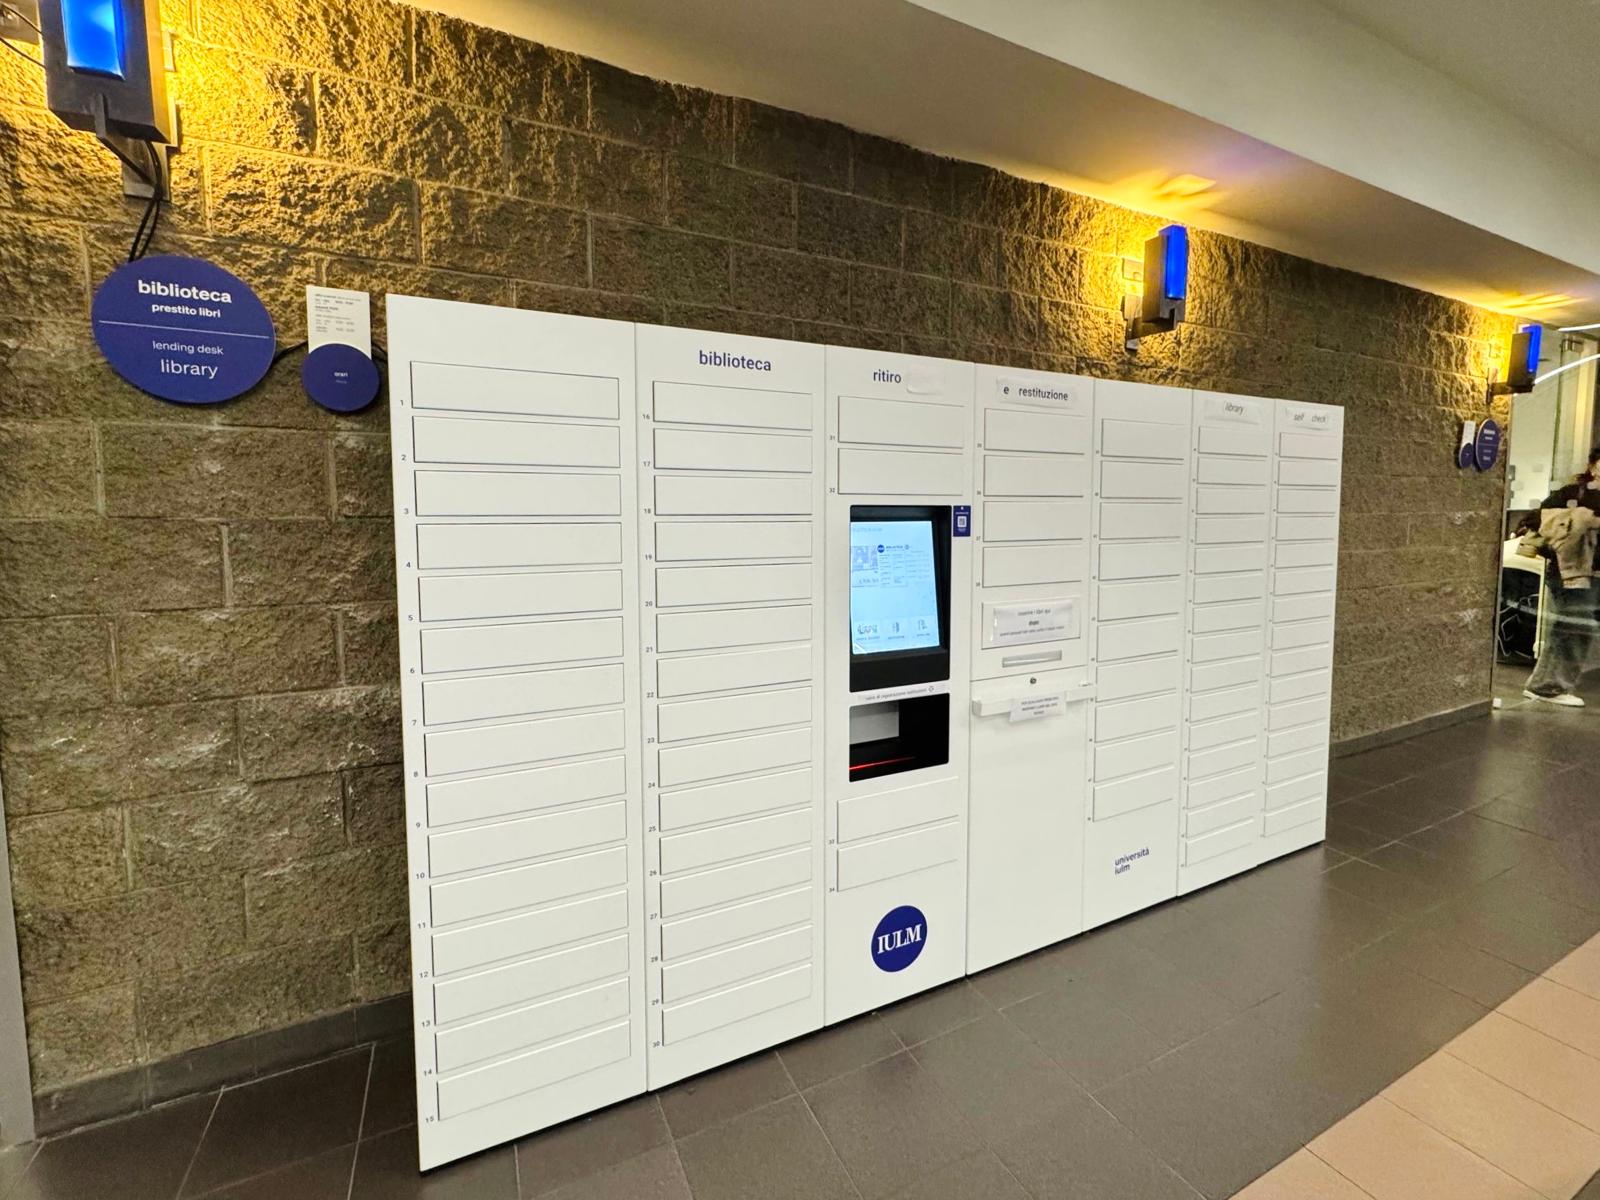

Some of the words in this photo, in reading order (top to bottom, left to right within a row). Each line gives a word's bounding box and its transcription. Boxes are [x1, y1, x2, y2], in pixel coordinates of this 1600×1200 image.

[138, 279, 232, 304] biblioteca
[151, 304, 197, 318] prestito
[199, 306, 221, 318] libri
[152, 340, 195, 355] lending
[197, 344, 224, 355] desk
[699, 350, 772, 372] biblioteca
[160, 359, 219, 379] library
[873, 368, 902, 384] ritiro
[1003, 385, 1009, 395] e
[1018, 386, 1069, 401] restituzione
[1224, 401, 1245, 415] library
[400, 454, 406, 462] 2
[404, 508, 410, 516] 3
[410, 666, 416, 674] 6
[412, 718, 418, 726] 7
[416, 822, 420, 830] 9
[1115, 846, 1150, 866] università
[1115, 863, 1131, 875] iulm
[416, 872, 426, 880] 10
[418, 922, 426, 930] 11
[877, 924, 922, 954] IULM
[418, 970, 428, 978] 12
[420, 1020, 430, 1028] 13
[424, 1068, 432, 1078] 14
[426, 1116, 434, 1124] 15
